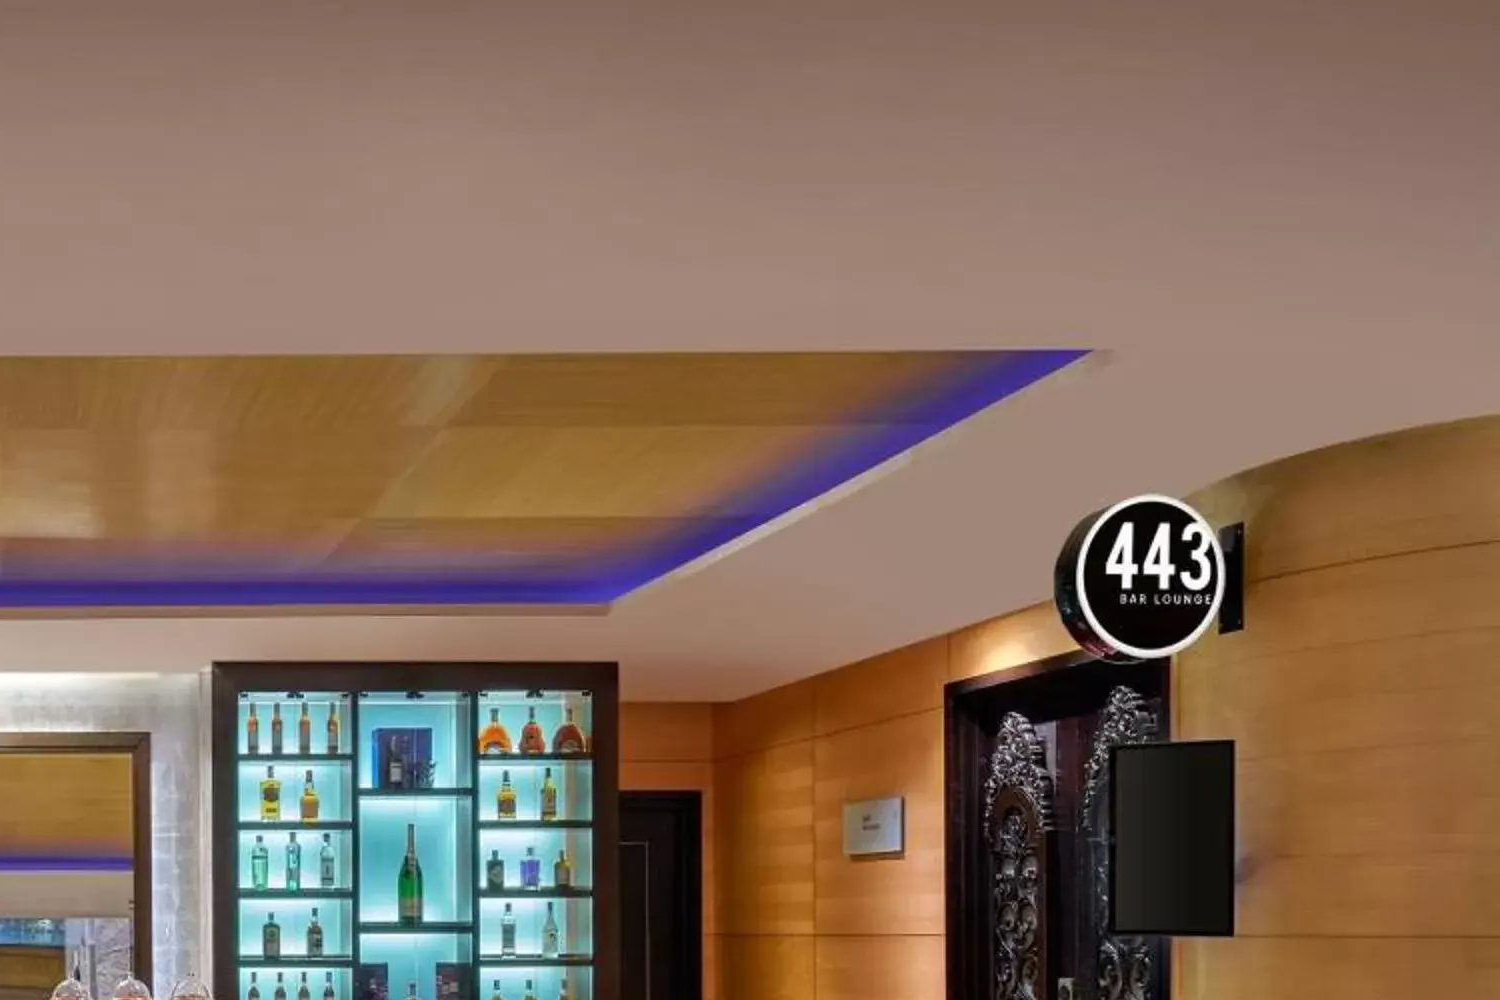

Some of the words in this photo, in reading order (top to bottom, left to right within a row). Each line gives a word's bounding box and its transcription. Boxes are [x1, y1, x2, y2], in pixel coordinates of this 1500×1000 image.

[1105, 521, 1212, 590] 443
[1119, 593, 1147, 605] BAR
[1153, 593, 1213, 605] LOUNGE
